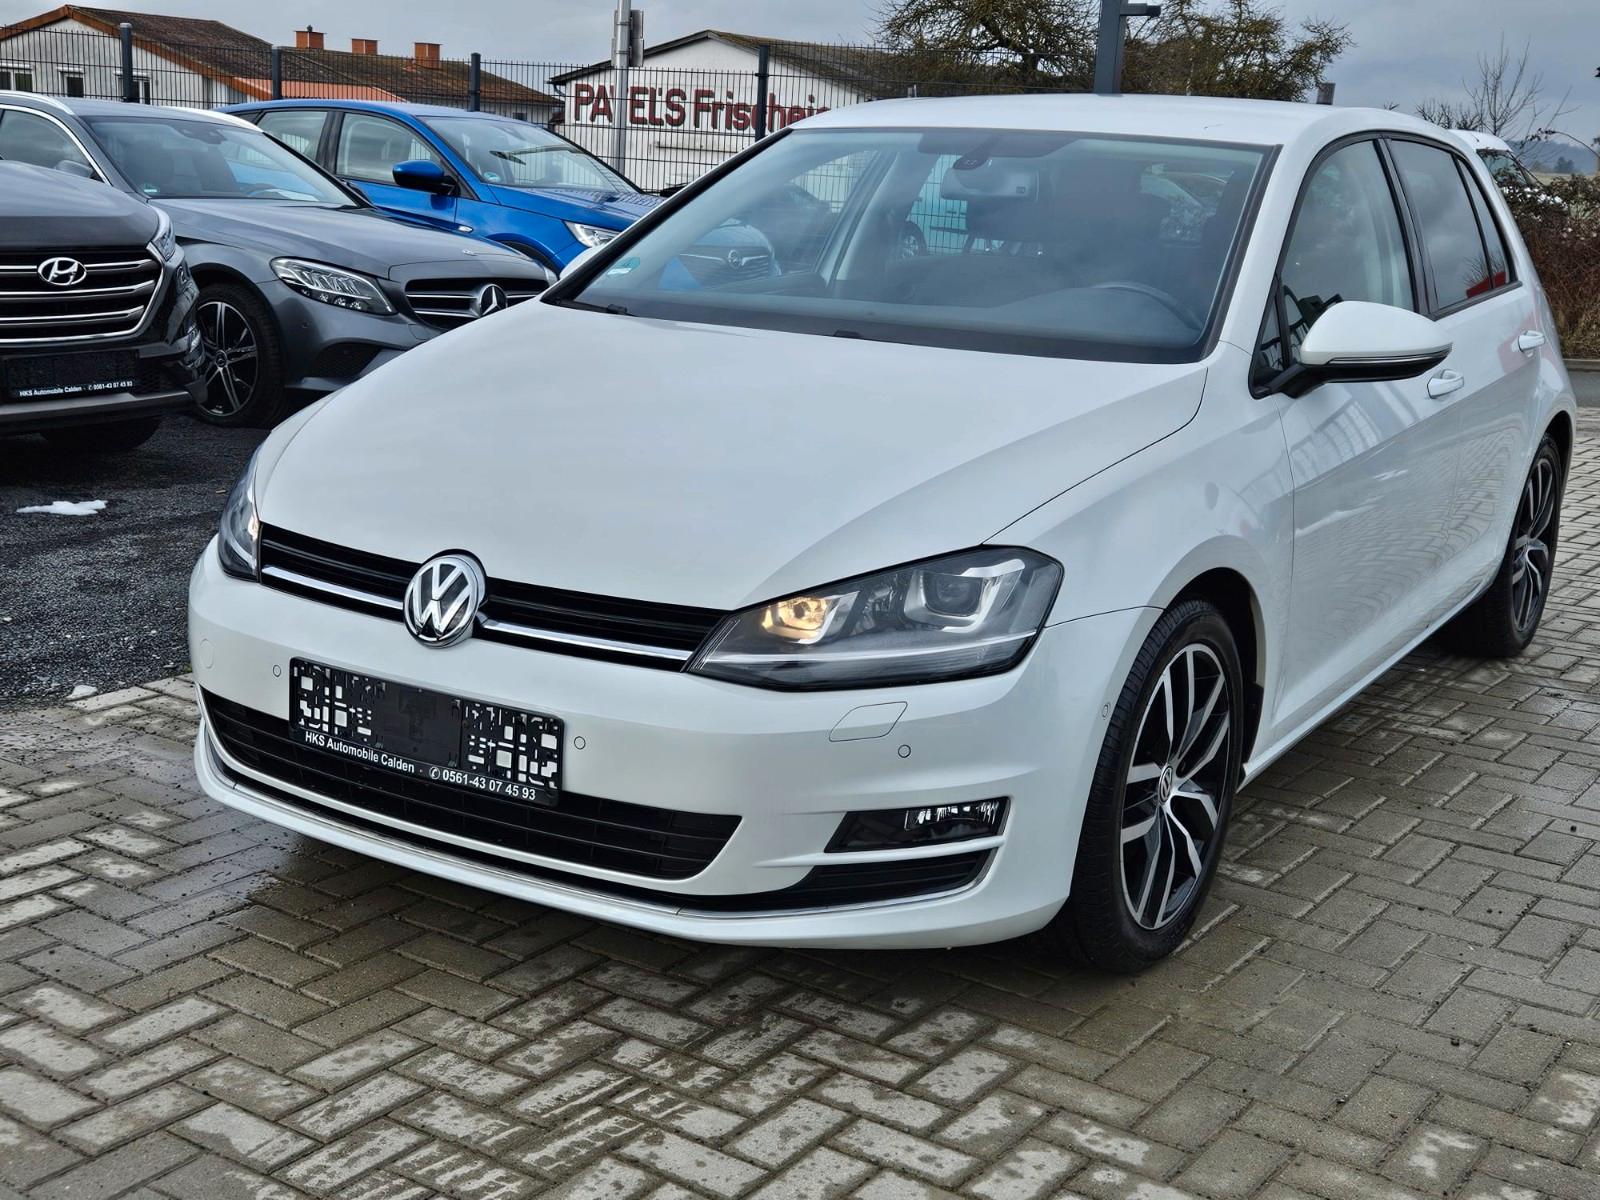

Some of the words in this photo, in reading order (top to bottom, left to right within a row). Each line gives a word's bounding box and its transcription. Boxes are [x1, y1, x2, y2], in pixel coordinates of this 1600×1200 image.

[574, 83, 687, 127] PAEL'S
[305, 731, 325, 747] HKS
[326, 738, 379, 762] Automobile
[381, 754, 415, 773] Calden
[442, 769, 486, 789] 0561-43
[489, 779, 502, 793] 07
[505, 784, 519, 797] 45
[522, 788, 536, 801] 93
